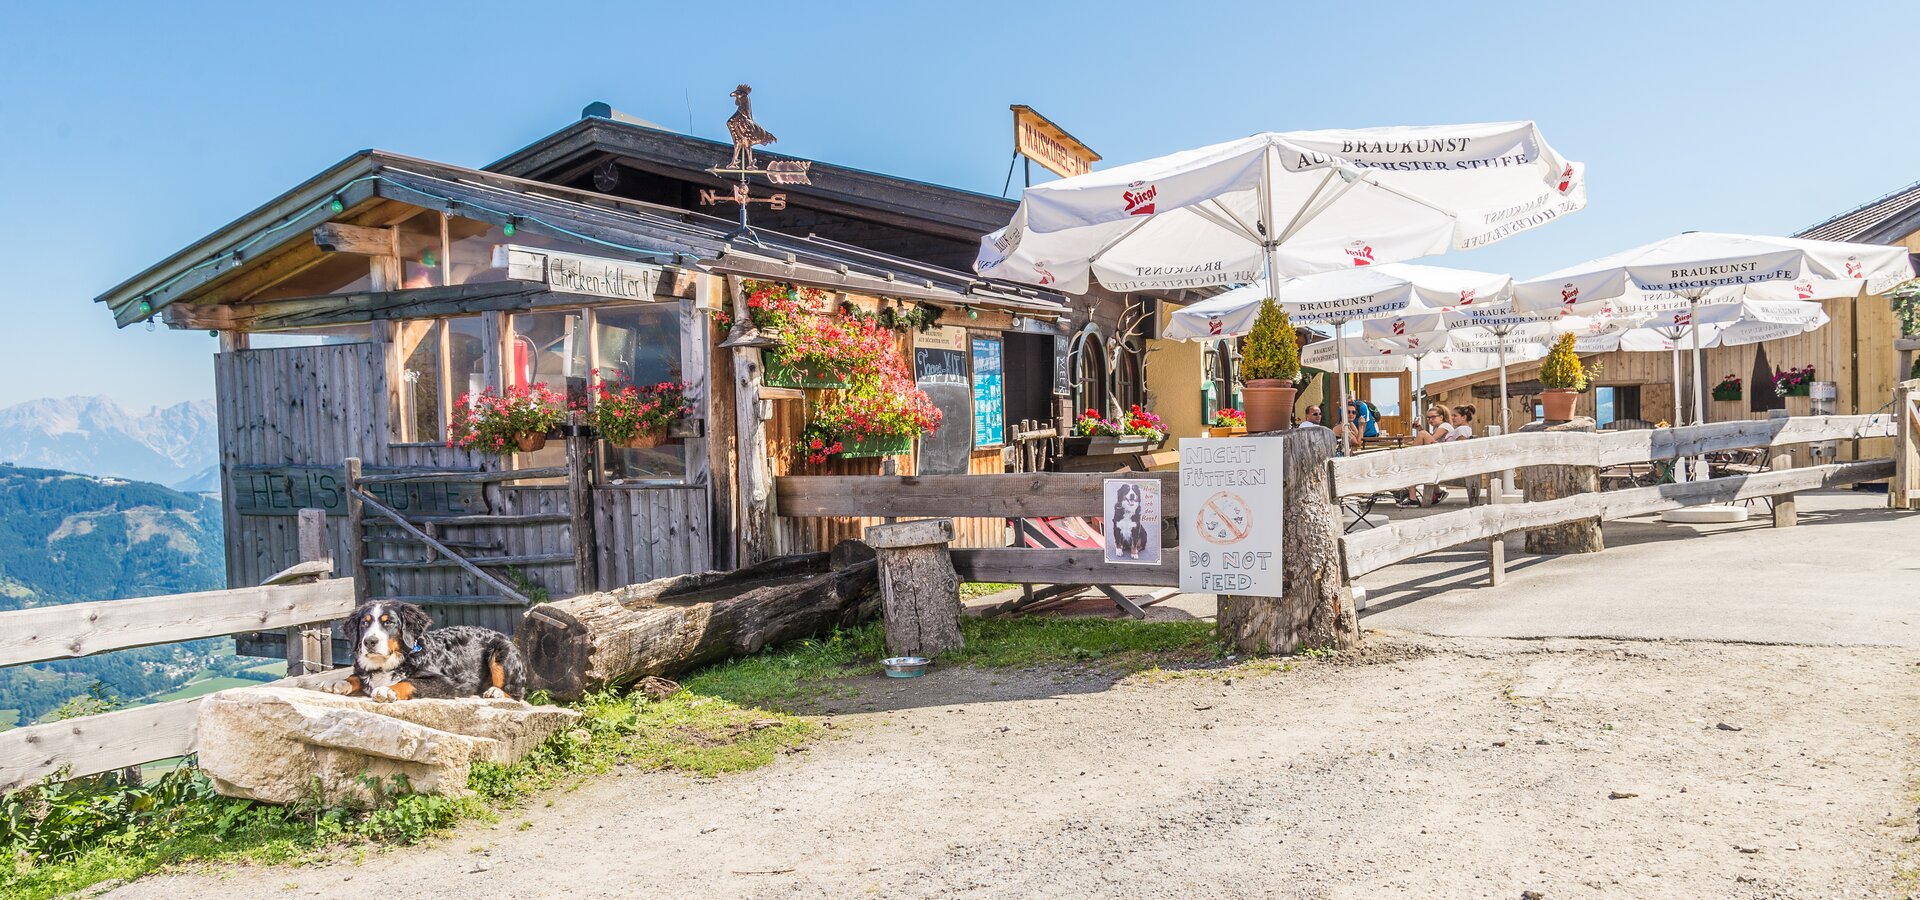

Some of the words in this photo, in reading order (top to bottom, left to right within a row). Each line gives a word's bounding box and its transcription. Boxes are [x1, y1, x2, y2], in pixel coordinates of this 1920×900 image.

[1341, 137, 1471, 153] BRAUKUNST
[700, 188, 716, 206] N
[770, 193, 787, 210] S
[1123, 184, 1157, 211] Stiegl
[1671, 262, 1757, 279] BRAUKUNST
[1669, 275, 1744, 290] HÖCHSTER
[1749, 270, 1792, 282] STUFE
[1300, 295, 1375, 311] BRAUKUNST
[1562, 288, 1579, 302] Stiegl
[1367, 301, 1406, 313] STUFE
[1450, 319, 1468, 328] AUF
[1186, 445, 1257, 464] NICHT
[1183, 467, 1267, 487] FÜTTERN
[1189, 551, 1211, 567] DO
[1222, 551, 1272, 571] NOT
